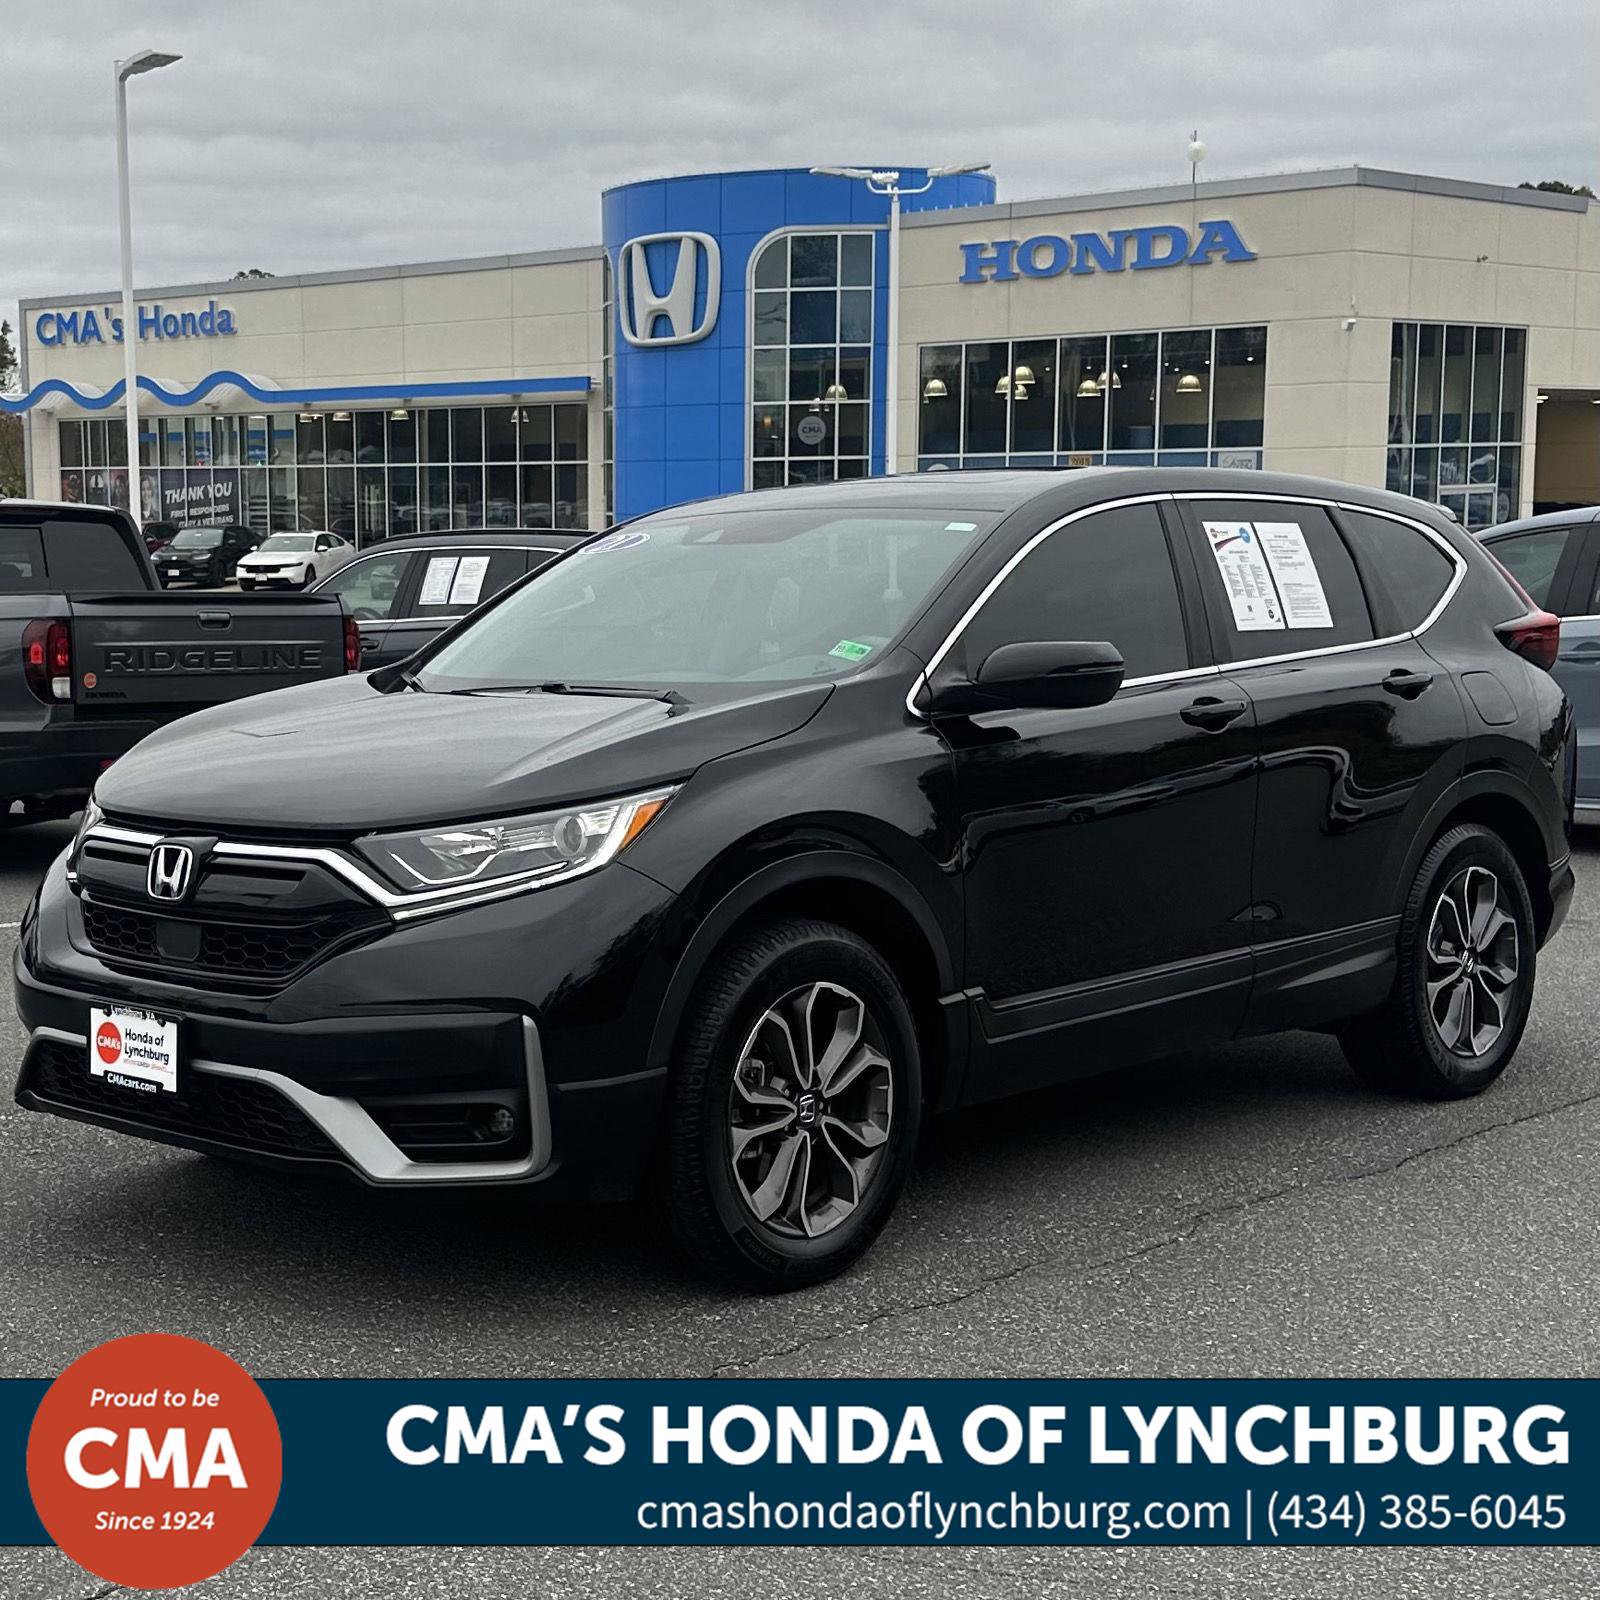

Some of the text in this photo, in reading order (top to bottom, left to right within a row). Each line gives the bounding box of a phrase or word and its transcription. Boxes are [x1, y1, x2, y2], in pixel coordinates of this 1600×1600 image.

[959, 219, 1257, 283] HONDA
[36, 300, 237, 346] CMA's Honda
[165, 482, 233, 504] THANK YOU
[104, 650, 322, 673] RIDGELINE
[124, 1027, 165, 1047] Honda of
[124, 1042, 170, 1066] Lynchburg
[106, 1072, 157, 1094] CMAcars.com
